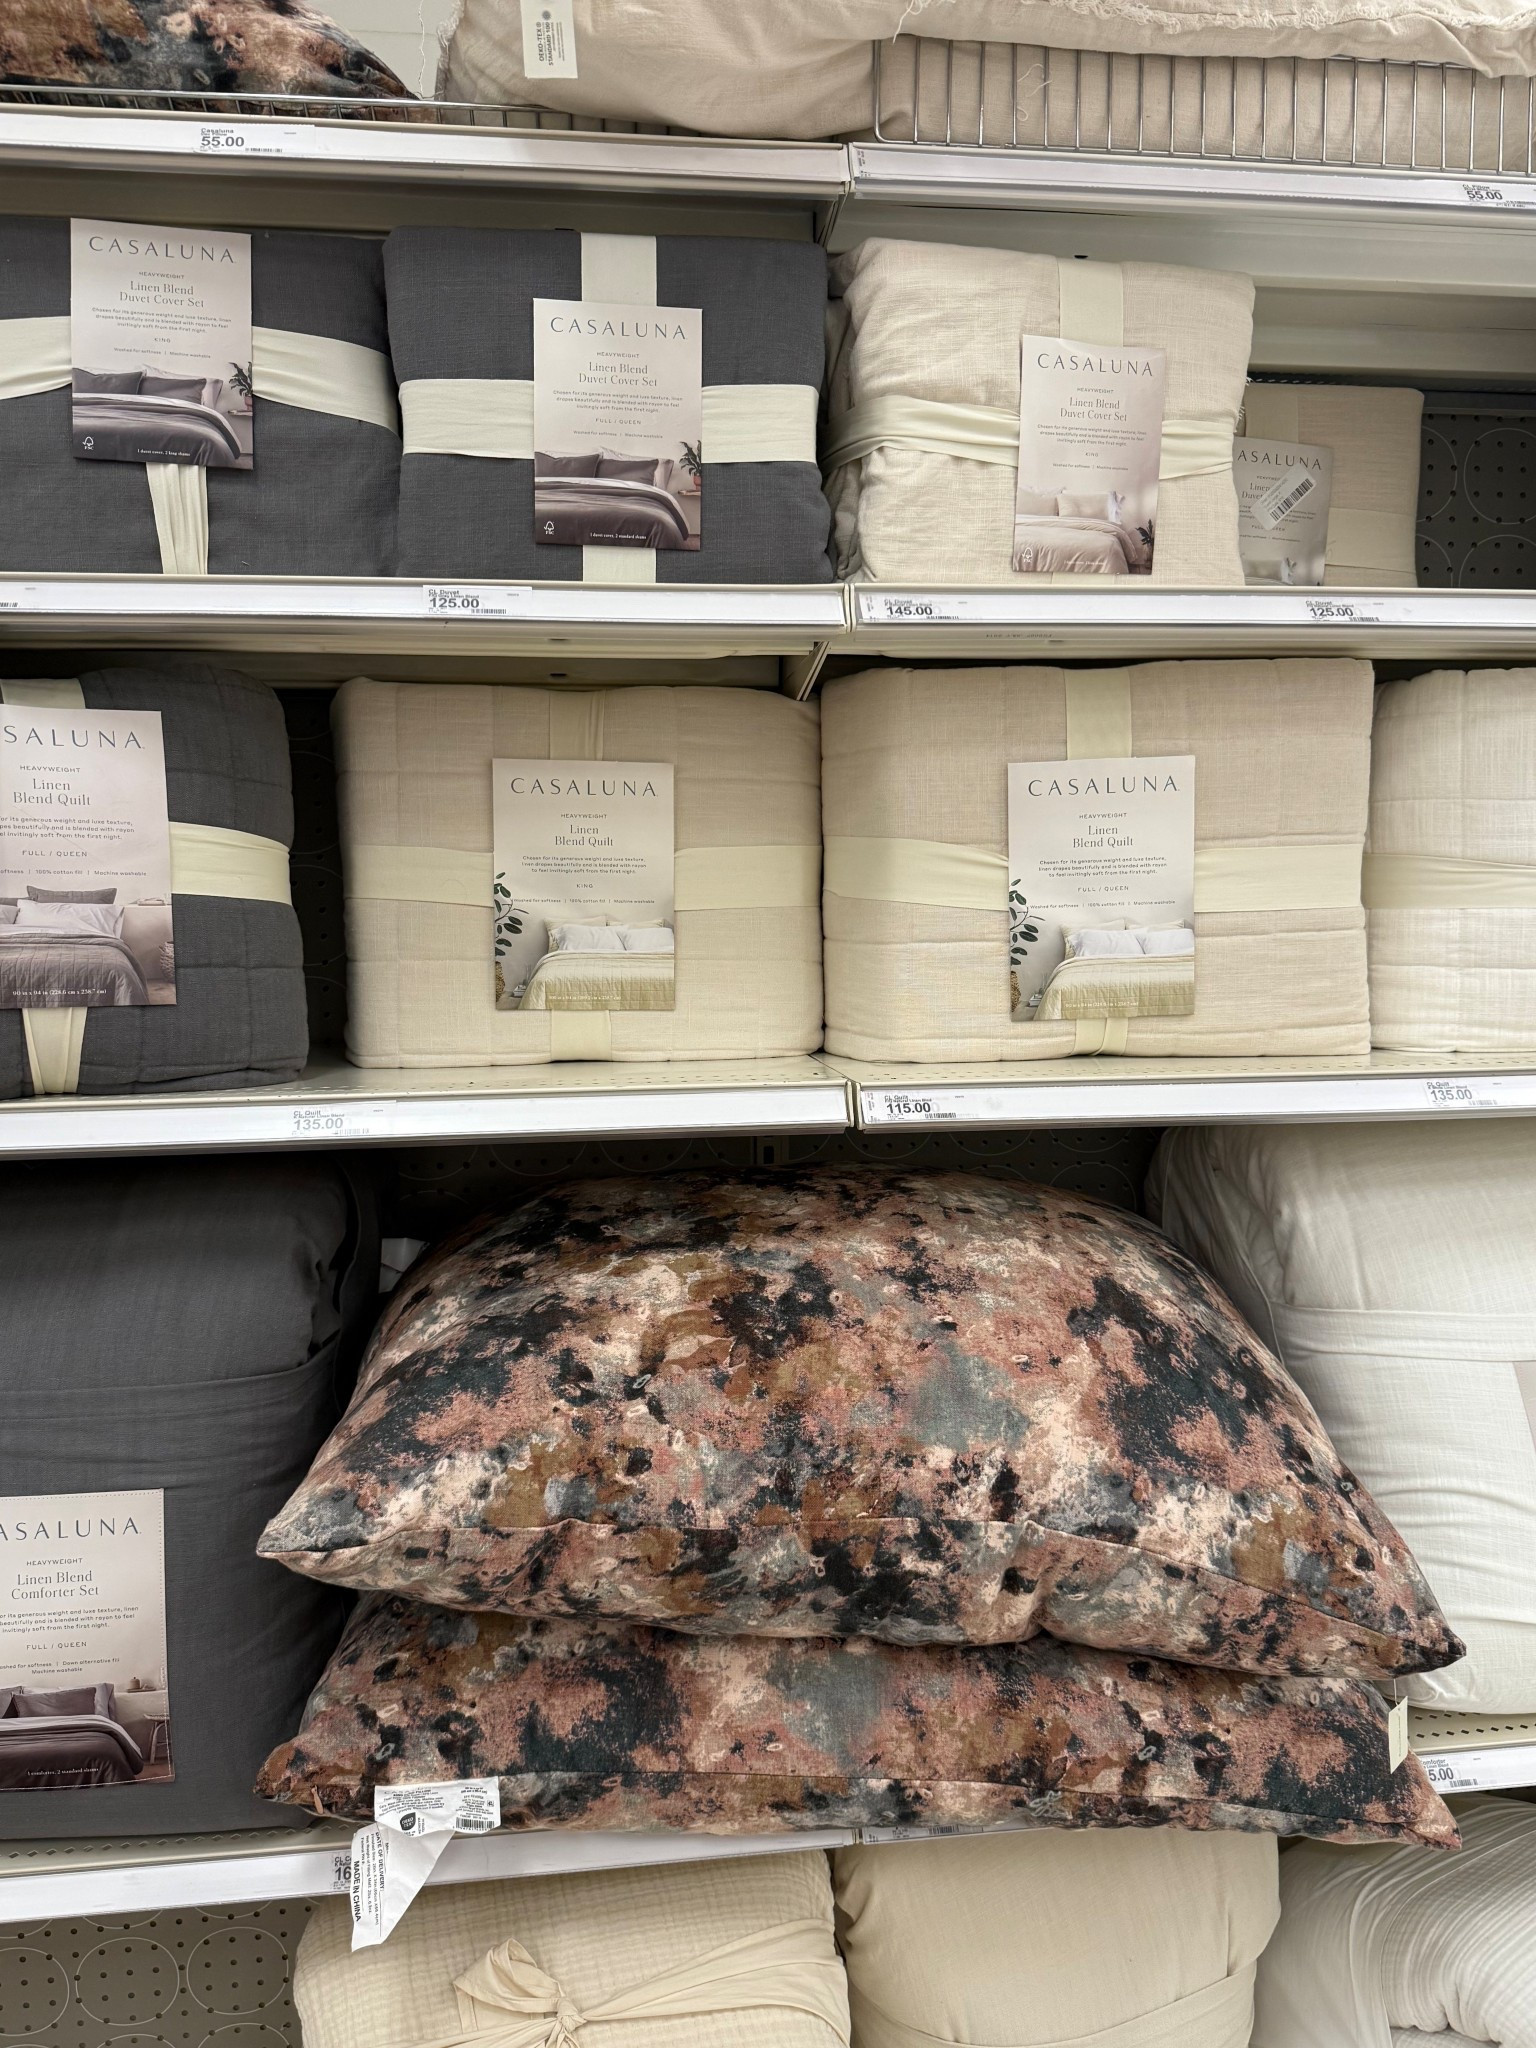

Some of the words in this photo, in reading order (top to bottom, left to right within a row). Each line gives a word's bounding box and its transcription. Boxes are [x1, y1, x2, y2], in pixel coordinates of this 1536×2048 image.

[201, 136, 245, 147] 55.00
[1467, 191, 1503, 200] 55.00
[89, 236, 235, 263] CASALUNA
[139, 271, 185, 279] HEAVYWEIGHT
[130, 281, 160, 293] Linen
[163, 284, 194, 295] Blend
[119, 292, 151, 304] Duvet
[154, 295, 184, 306] Cover
[187, 297, 204, 308] Set
[550, 316, 686, 340] CASALUNA
[589, 362, 616, 373] Linen
[619, 363, 648, 374] Blend
[1037, 353, 1153, 376] CASALUNA
[579, 373, 607, 384] Duvet
[611, 376, 639, 386] Cover
[642, 377, 657, 387] Set
[1069, 397, 1093, 408] Linen
[1096, 399, 1120, 409] Blend
[1060, 408, 1085, 419] Duvet
[1087, 410, 1112, 421] Cover
[1114, 412, 1127, 422] Set
[430, 598, 479, 608] 125.00
[887, 606, 933, 615] 145.00
[1310, 608, 1354, 616] 125.00
[20, 765, 81, 773] HEAVYWEIGHT
[32, 778, 71, 791] Linen
[510, 777, 656, 797] CASALUNA
[1028, 775, 1178, 797] CASALUNA
[13, 792, 53, 804] Blend
[58, 793, 91, 807] Quilt
[20, 817, 52, 825] generous
[13, 824, 50, 832] beautifully
[570, 824, 599, 834] Linen
[1088, 825, 1118, 835] Linen
[7, 831, 39, 839] invitingly
[555, 836, 585, 846] Blend
[588, 836, 614, 848] Quilt
[1073, 838, 1103, 848] Blend
[1107, 836, 1133, 848] Quilt
[1430, 1089, 1472, 1101] 135.00
[886, 1102, 931, 1113] 115.00
[294, 1118, 343, 1130] 135.00
[26, 1558, 83, 1566] HEAVYWEIGHT
[17, 1574, 52, 1586] Linen
[56, 1570, 93, 1583] Blend
[11, 1587, 75, 1600] Comforter
[79, 1585, 99, 1597] Set
[18, 1611, 46, 1620] generous
[91, 1622, 110, 1630] night.
[1428, 1768, 1454, 1781] 5.00
[375, 1832, 384, 1848] DATE
[335, 1866, 351, 1880] 16
[353, 1860, 361, 1885] MADE
[352, 1886, 360, 1894] IN
[353, 1895, 362, 1922] CHINA
